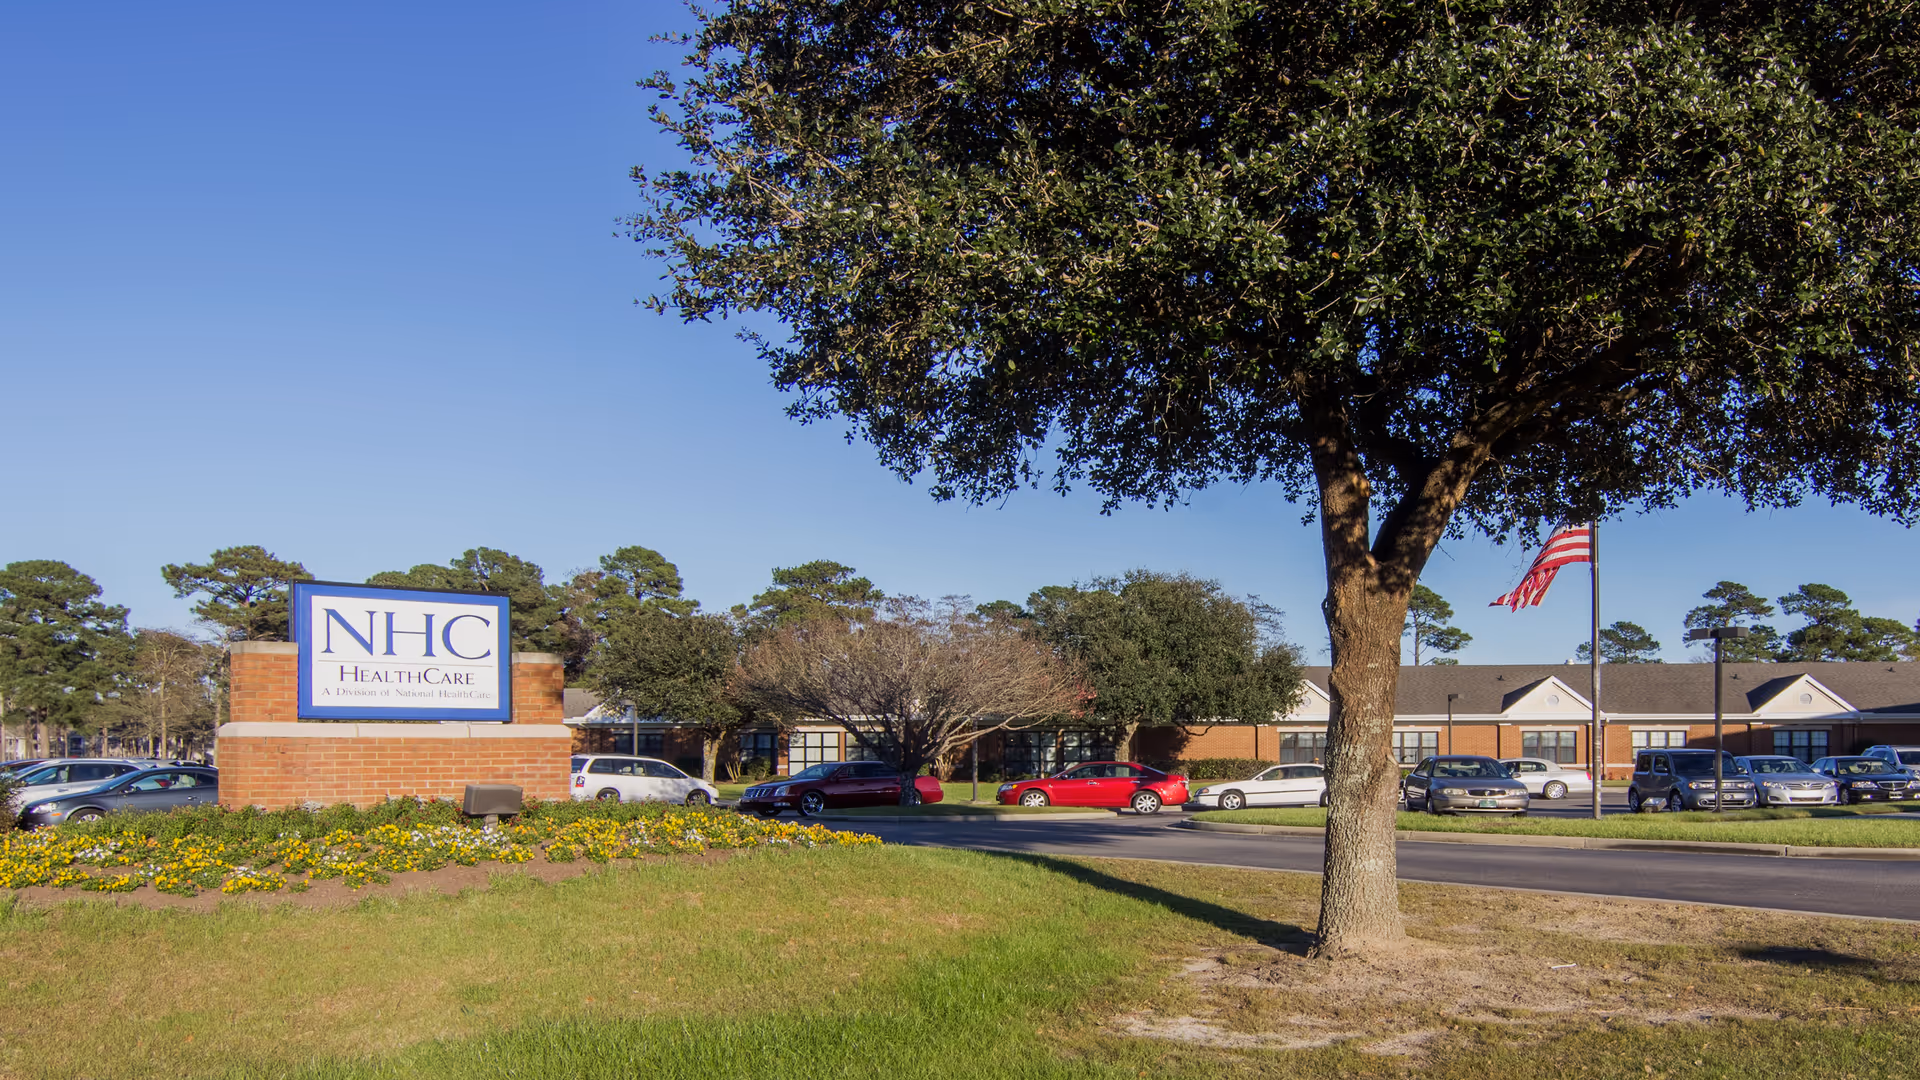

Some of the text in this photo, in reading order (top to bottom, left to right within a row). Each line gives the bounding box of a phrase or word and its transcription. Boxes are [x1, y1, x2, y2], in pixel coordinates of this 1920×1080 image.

[321, 608, 491, 660] NHC
[321, 687, 491, 699] A Division of National HealthCare
